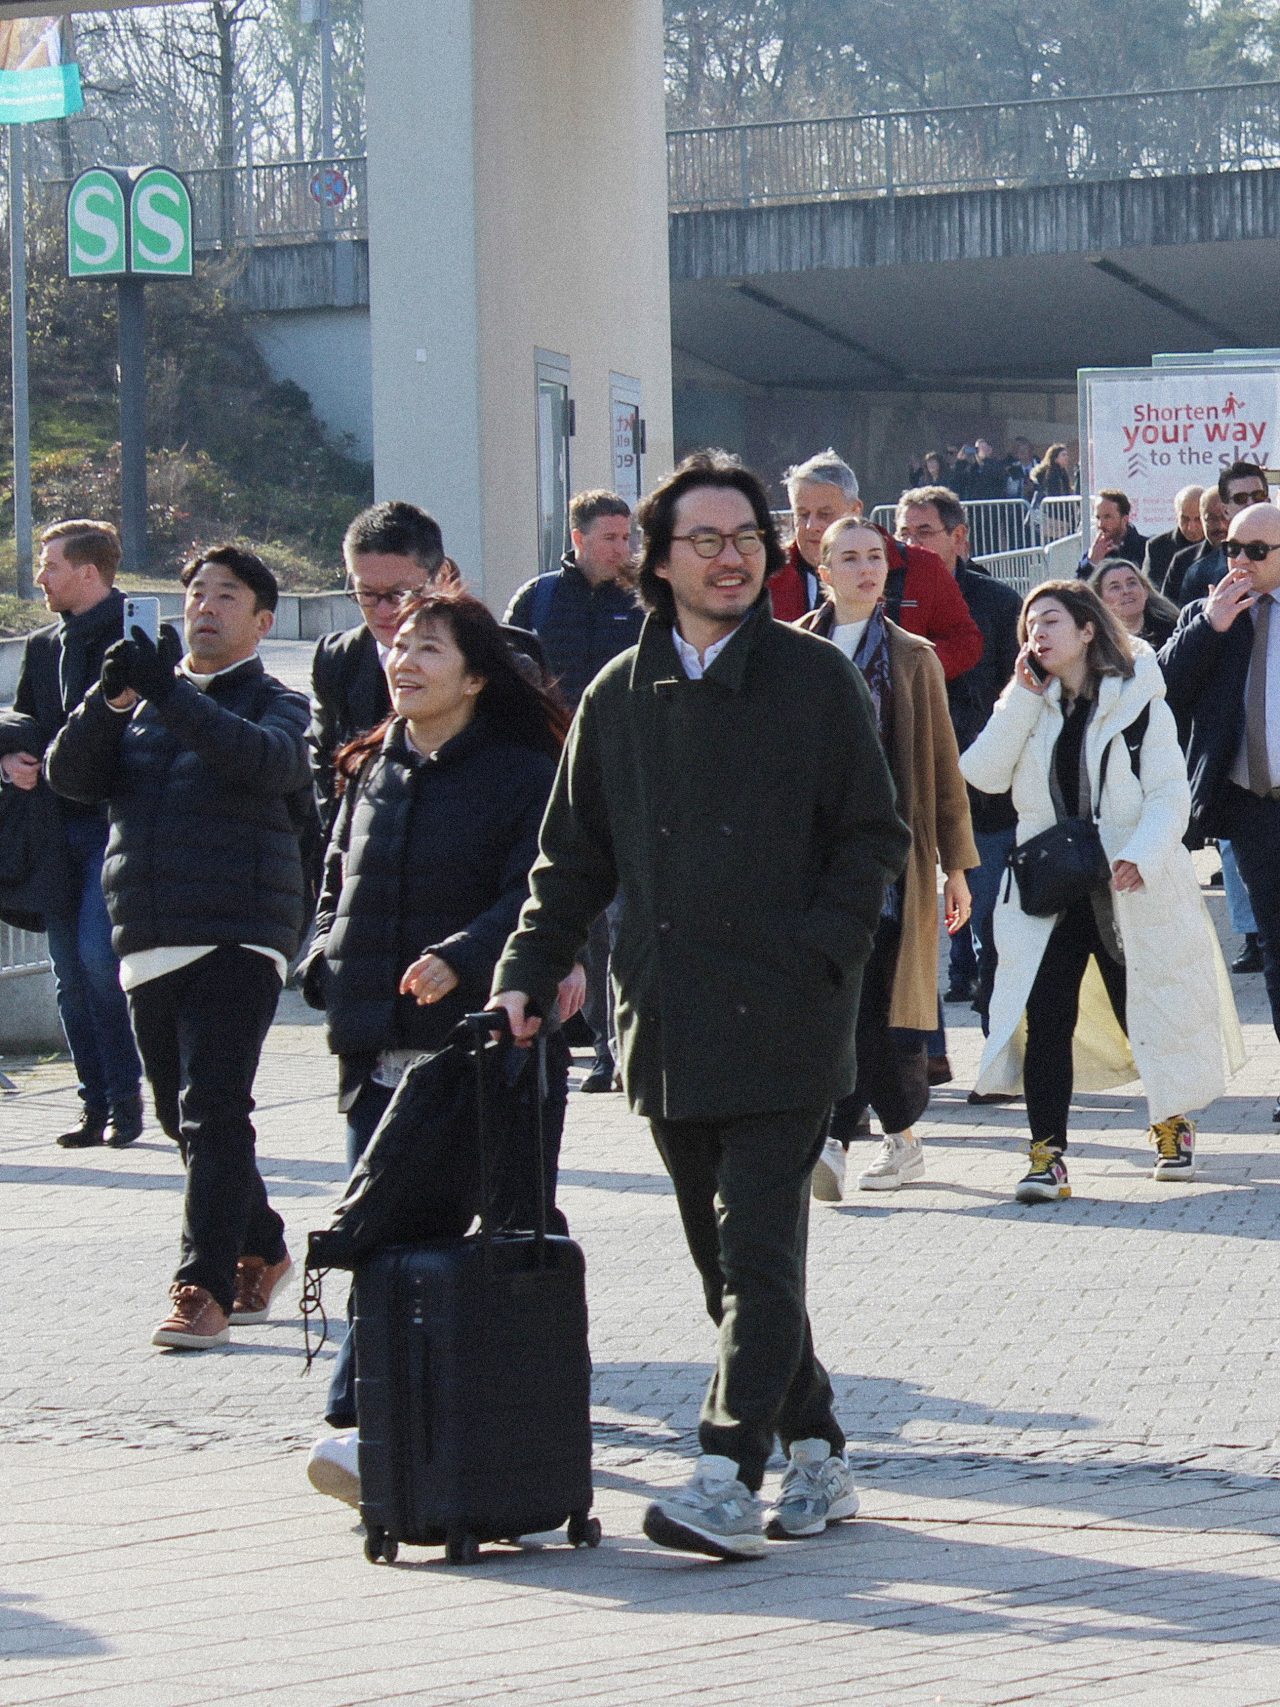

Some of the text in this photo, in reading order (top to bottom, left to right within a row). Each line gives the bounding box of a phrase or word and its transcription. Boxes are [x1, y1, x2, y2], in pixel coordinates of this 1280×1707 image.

[75, 185, 119, 265] S
[137, 183, 185, 264] S
[1134, 403, 1218, 422] Shorten
[1122, 421, 1267, 453] your way
[1150, 449, 1171, 466] to
[1178, 447, 1213, 465] the
